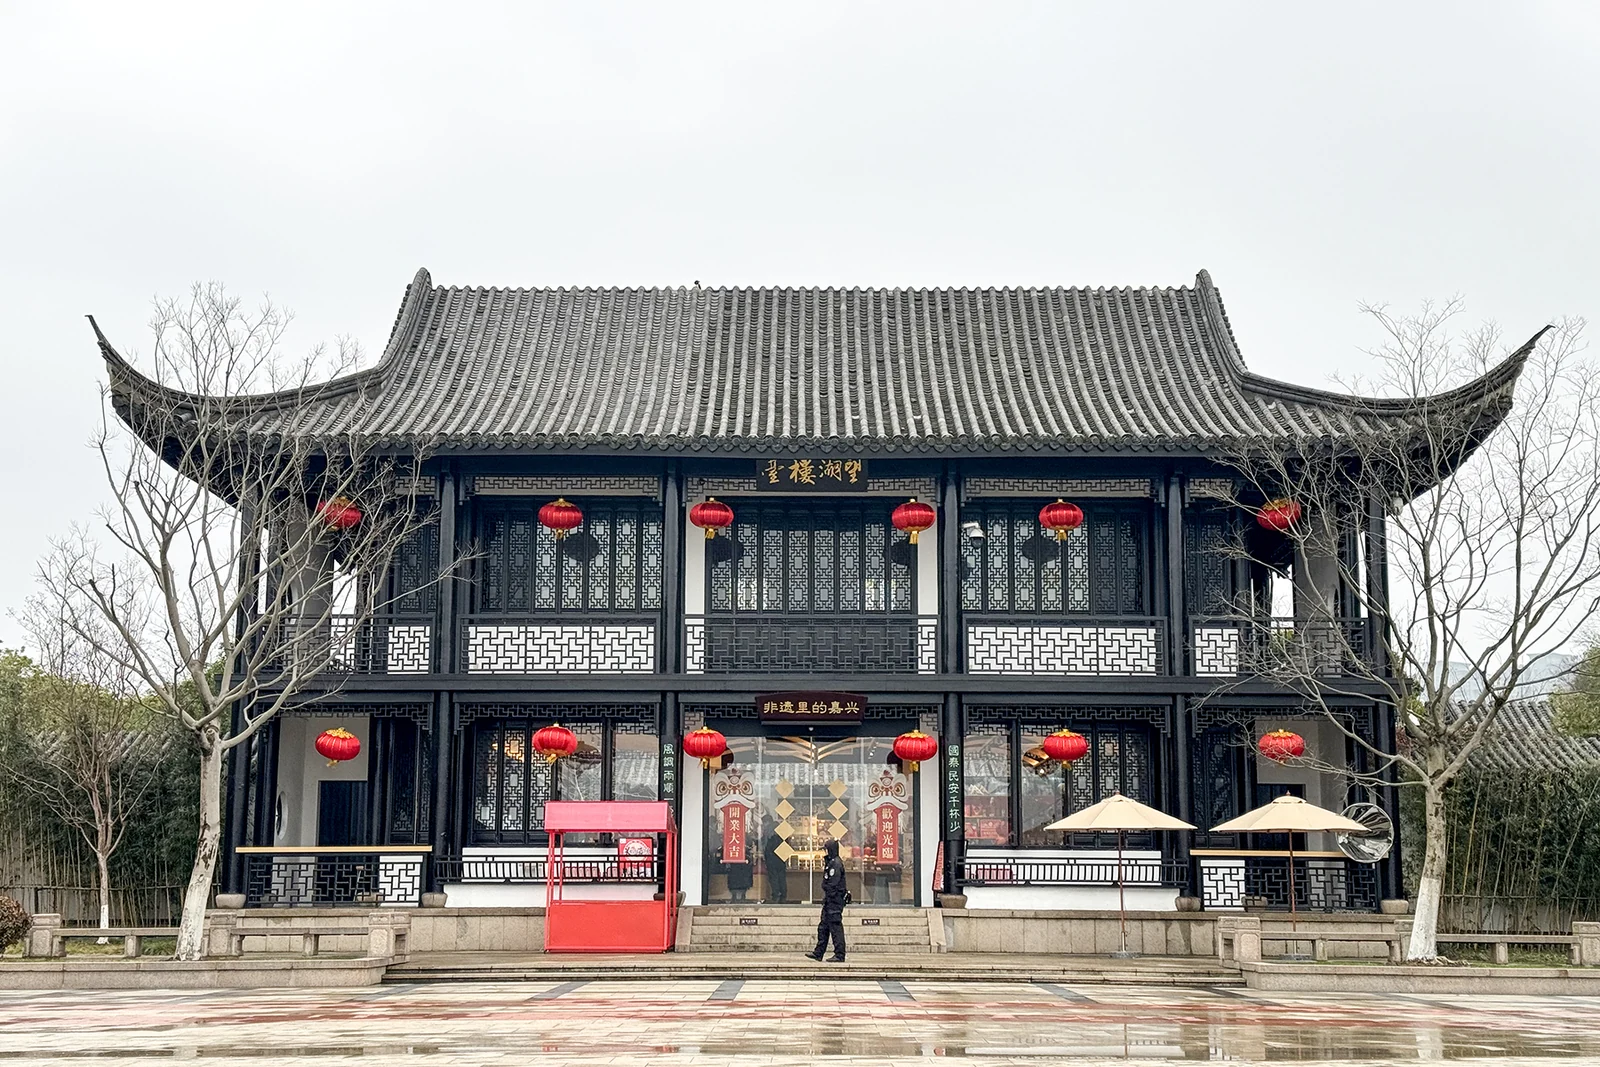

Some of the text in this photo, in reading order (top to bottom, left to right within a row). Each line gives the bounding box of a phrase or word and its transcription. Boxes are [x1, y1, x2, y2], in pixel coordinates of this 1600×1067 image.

[729, 807, 741, 858] 開業大吉
[882, 808, 894, 859] 歡迎光臨
